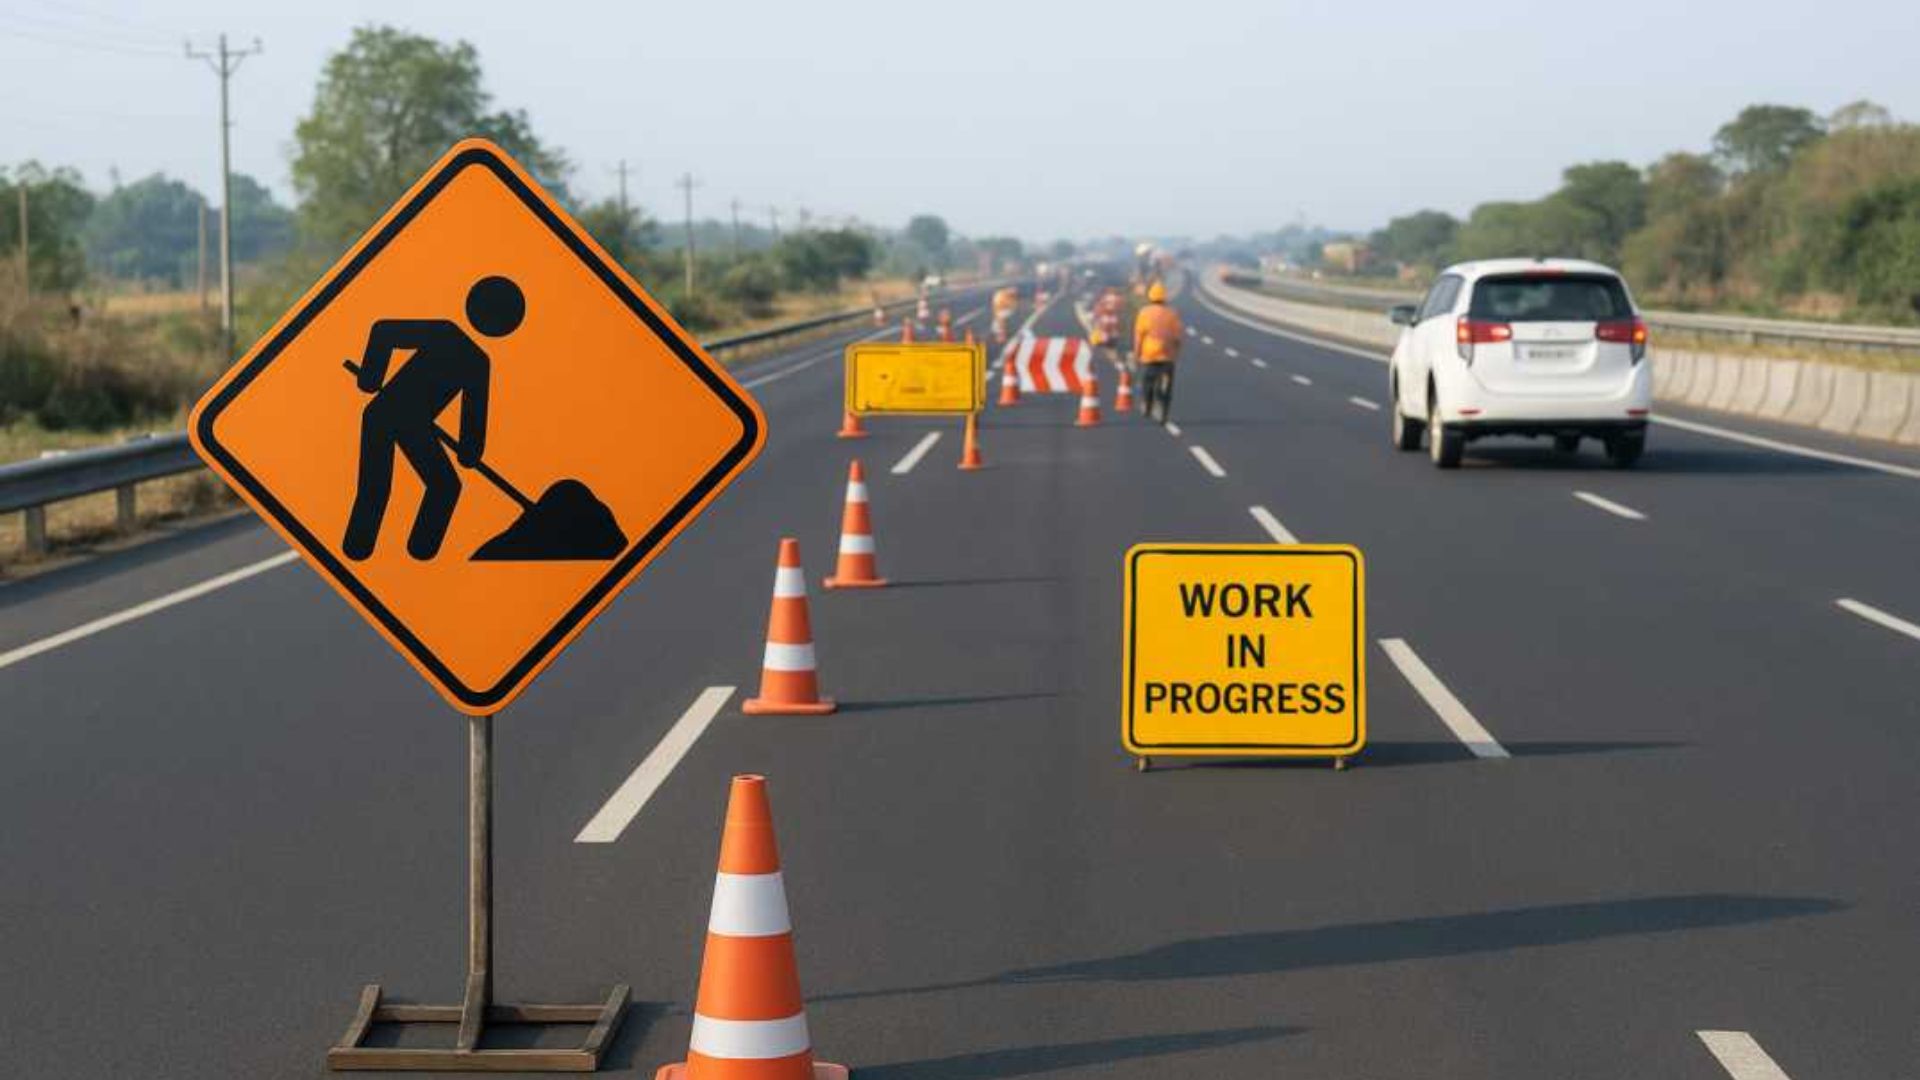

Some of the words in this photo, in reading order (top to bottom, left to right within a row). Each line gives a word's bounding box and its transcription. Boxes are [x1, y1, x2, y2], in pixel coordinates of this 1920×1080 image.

[1179, 583, 1313, 618] WORK
[1226, 633, 1266, 668] IN
[1144, 682, 1346, 714] PROGRESS
